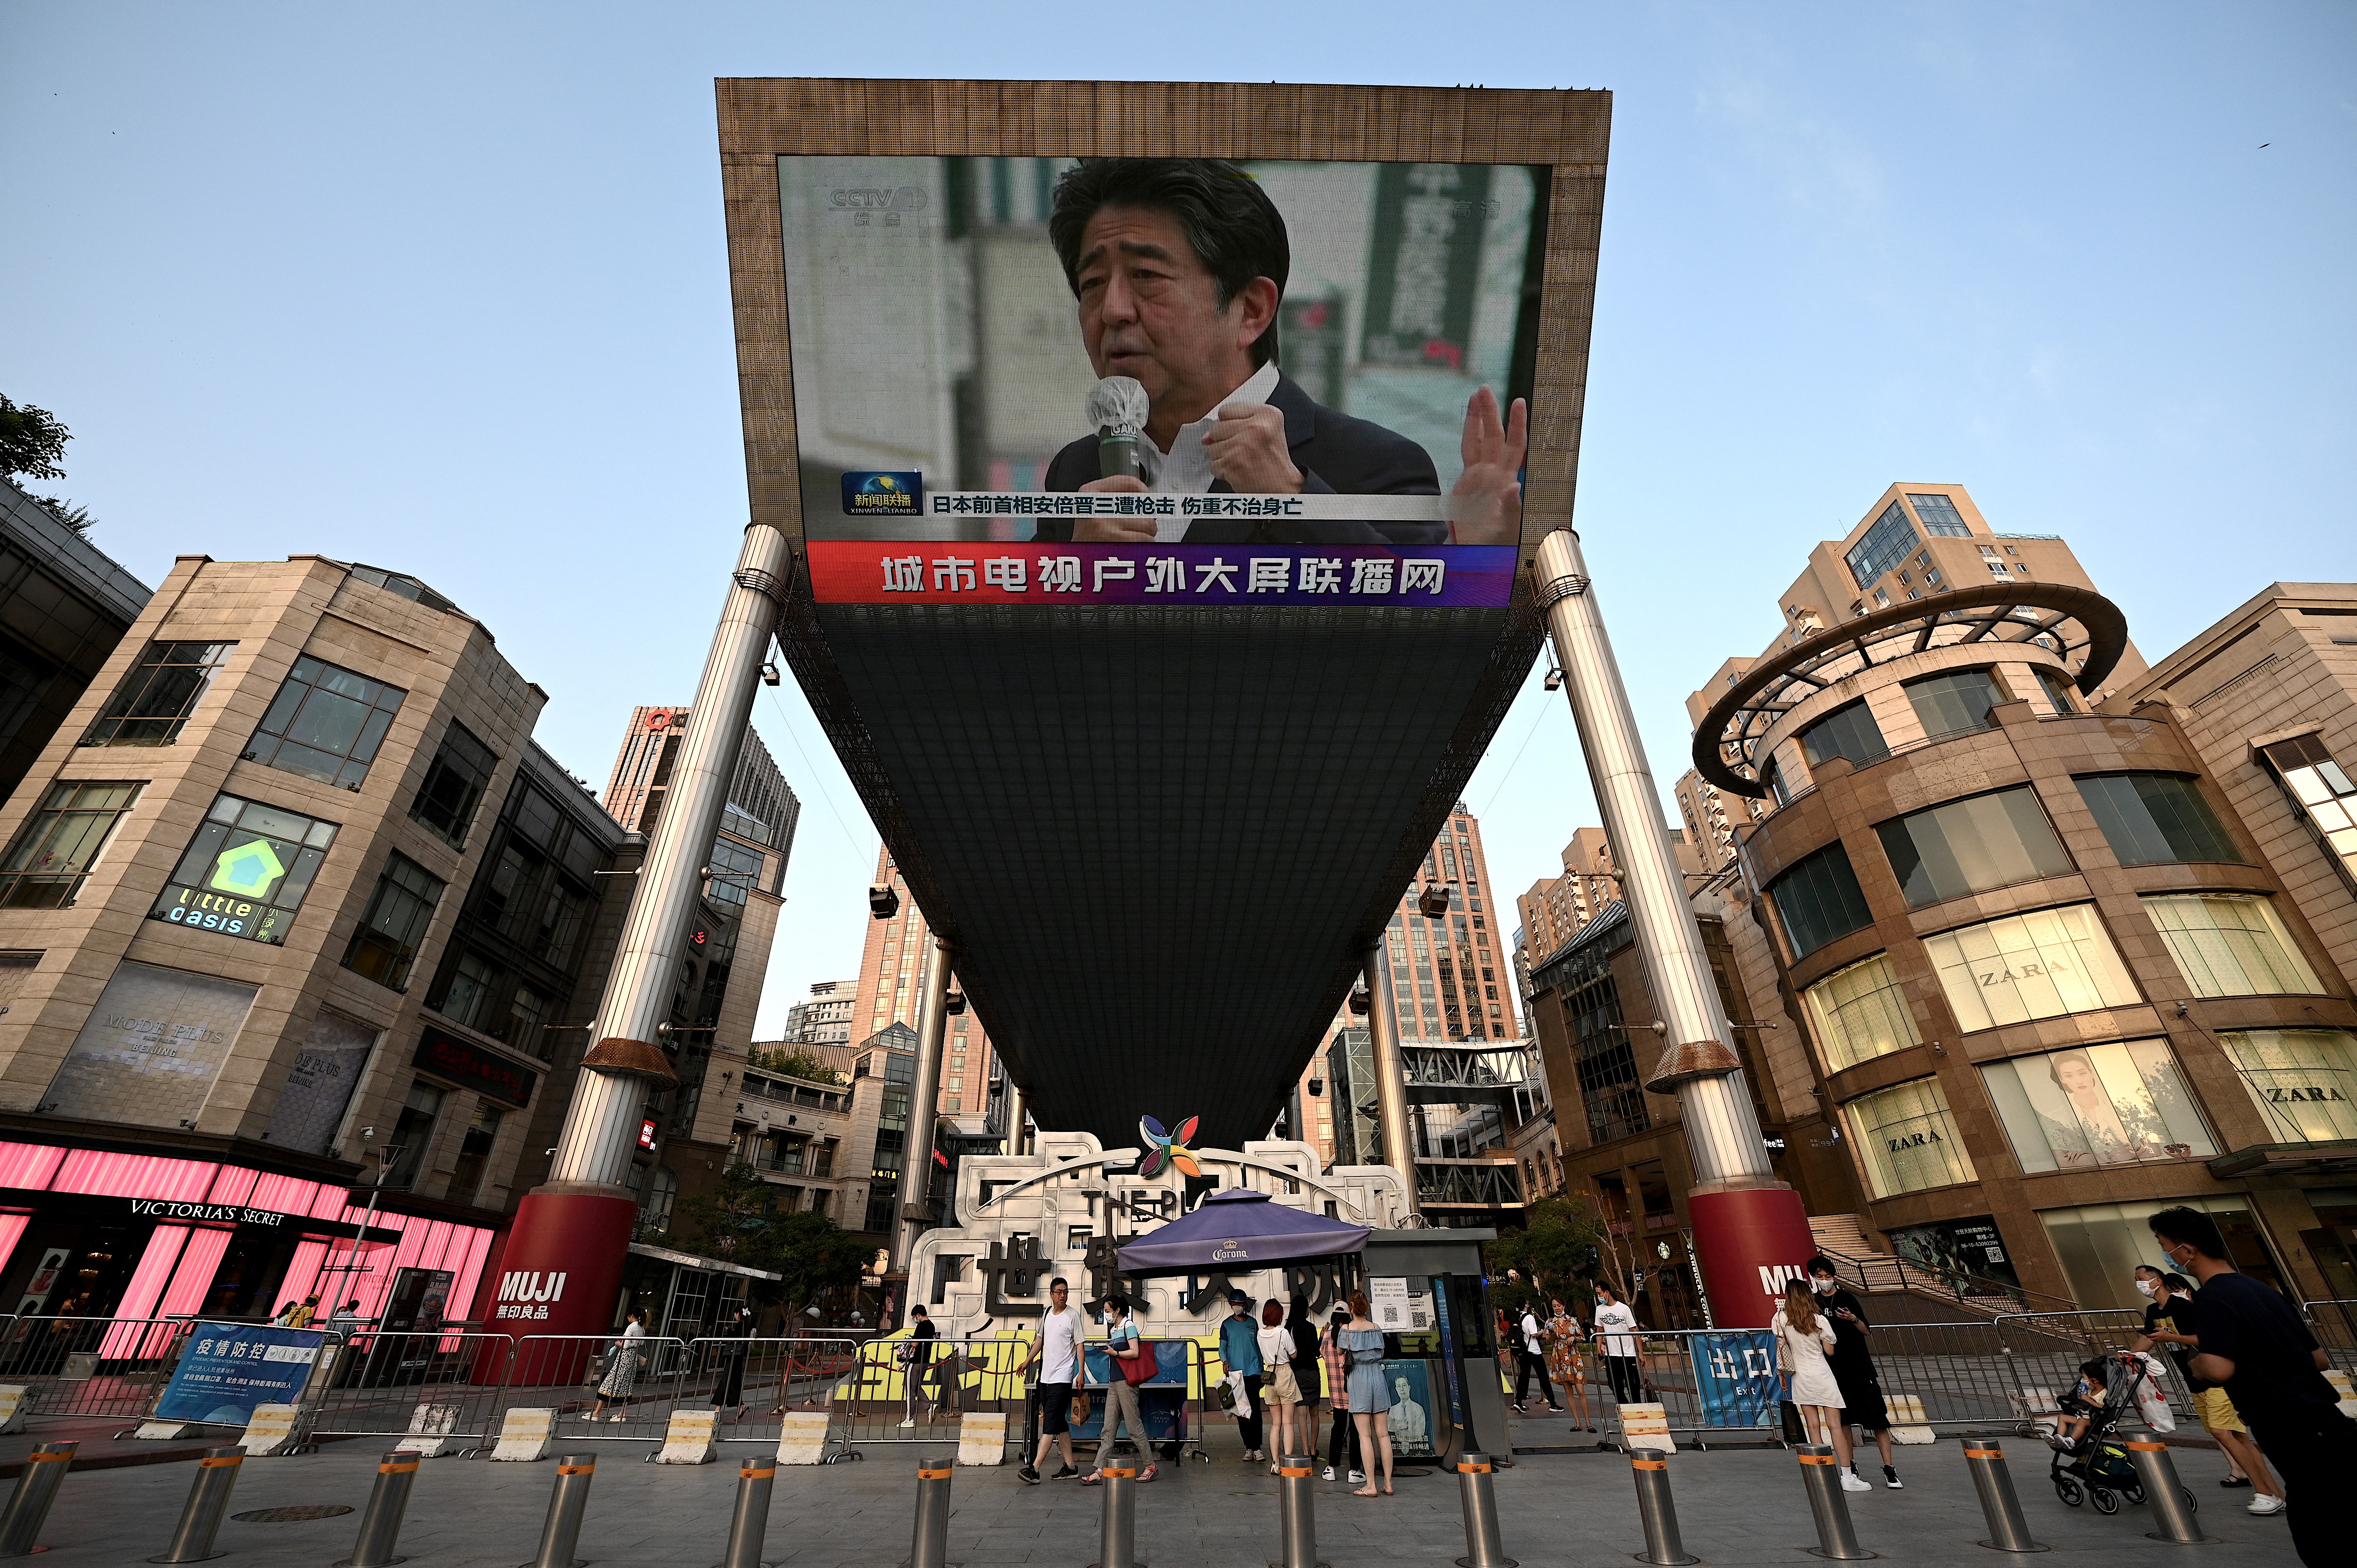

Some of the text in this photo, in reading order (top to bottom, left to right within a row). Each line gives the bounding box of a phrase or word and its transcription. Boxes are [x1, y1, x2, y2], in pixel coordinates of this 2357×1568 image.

[830, 189, 892, 207] CCTV
[854, 493, 911, 507] 新闻联播
[933, 495, 1303, 516] 日本前首相安倍晋三遭枪击 伤重不治身亡
[881, 555, 1446, 595] 城市电视户外大屏联播网
[179, 888, 252, 917] little
[170, 907, 244, 934] oasis
[1980, 960, 2068, 987] ZARA
[102, 1015, 224, 1044] MODE PLUS
[131, 1043, 177, 1057] BEIJING
[312, 1058, 341, 1077] PLUS
[2267, 1087, 2346, 1103] ZARA
[736, 1103, 797, 1126] 天 阶
[1889, 1130, 1944, 1153] ZARA
[132, 1200, 284, 1226] VICTORIA'S SECRET
[1081, 1191, 1147, 1217] THE
[1955, 1226, 1993, 1234] 世贸天阶购物中心
[1212, 1249, 1247, 1262] Corona
[498, 1271, 567, 1302] MUJI
[496, 1304, 549, 1320] 無印良品
[196, 1338, 266, 1360] 疫情防控
[1707, 1348, 1773, 1379] 出口
